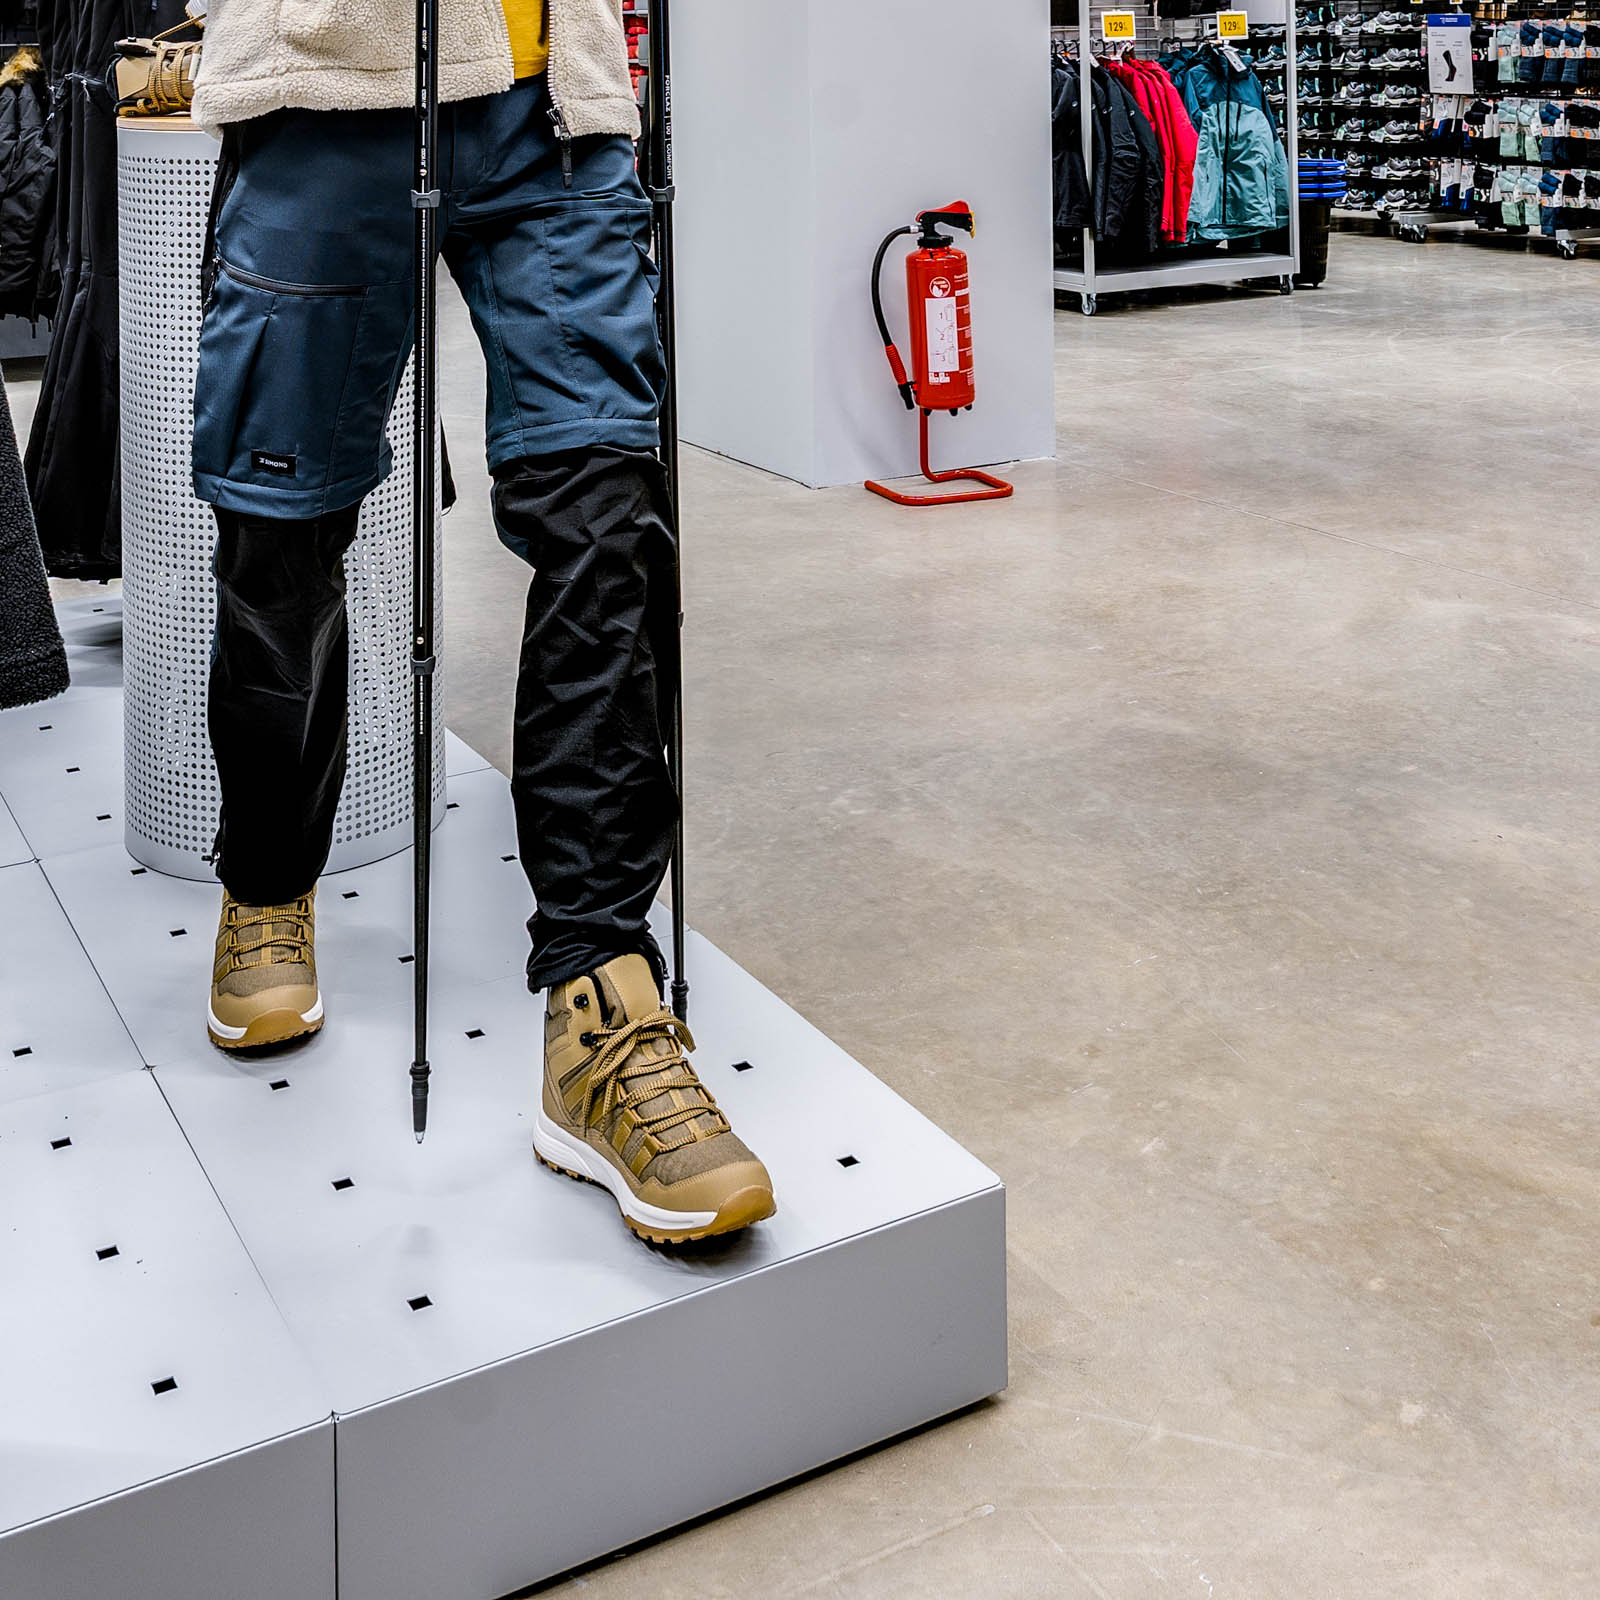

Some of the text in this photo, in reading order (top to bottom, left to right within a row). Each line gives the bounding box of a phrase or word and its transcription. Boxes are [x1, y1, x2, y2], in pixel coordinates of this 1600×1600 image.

[1108, 21, 1124, 32] 129
[1223, 20, 1237, 31] 129
[264, 459, 288, 469] SIMOND
